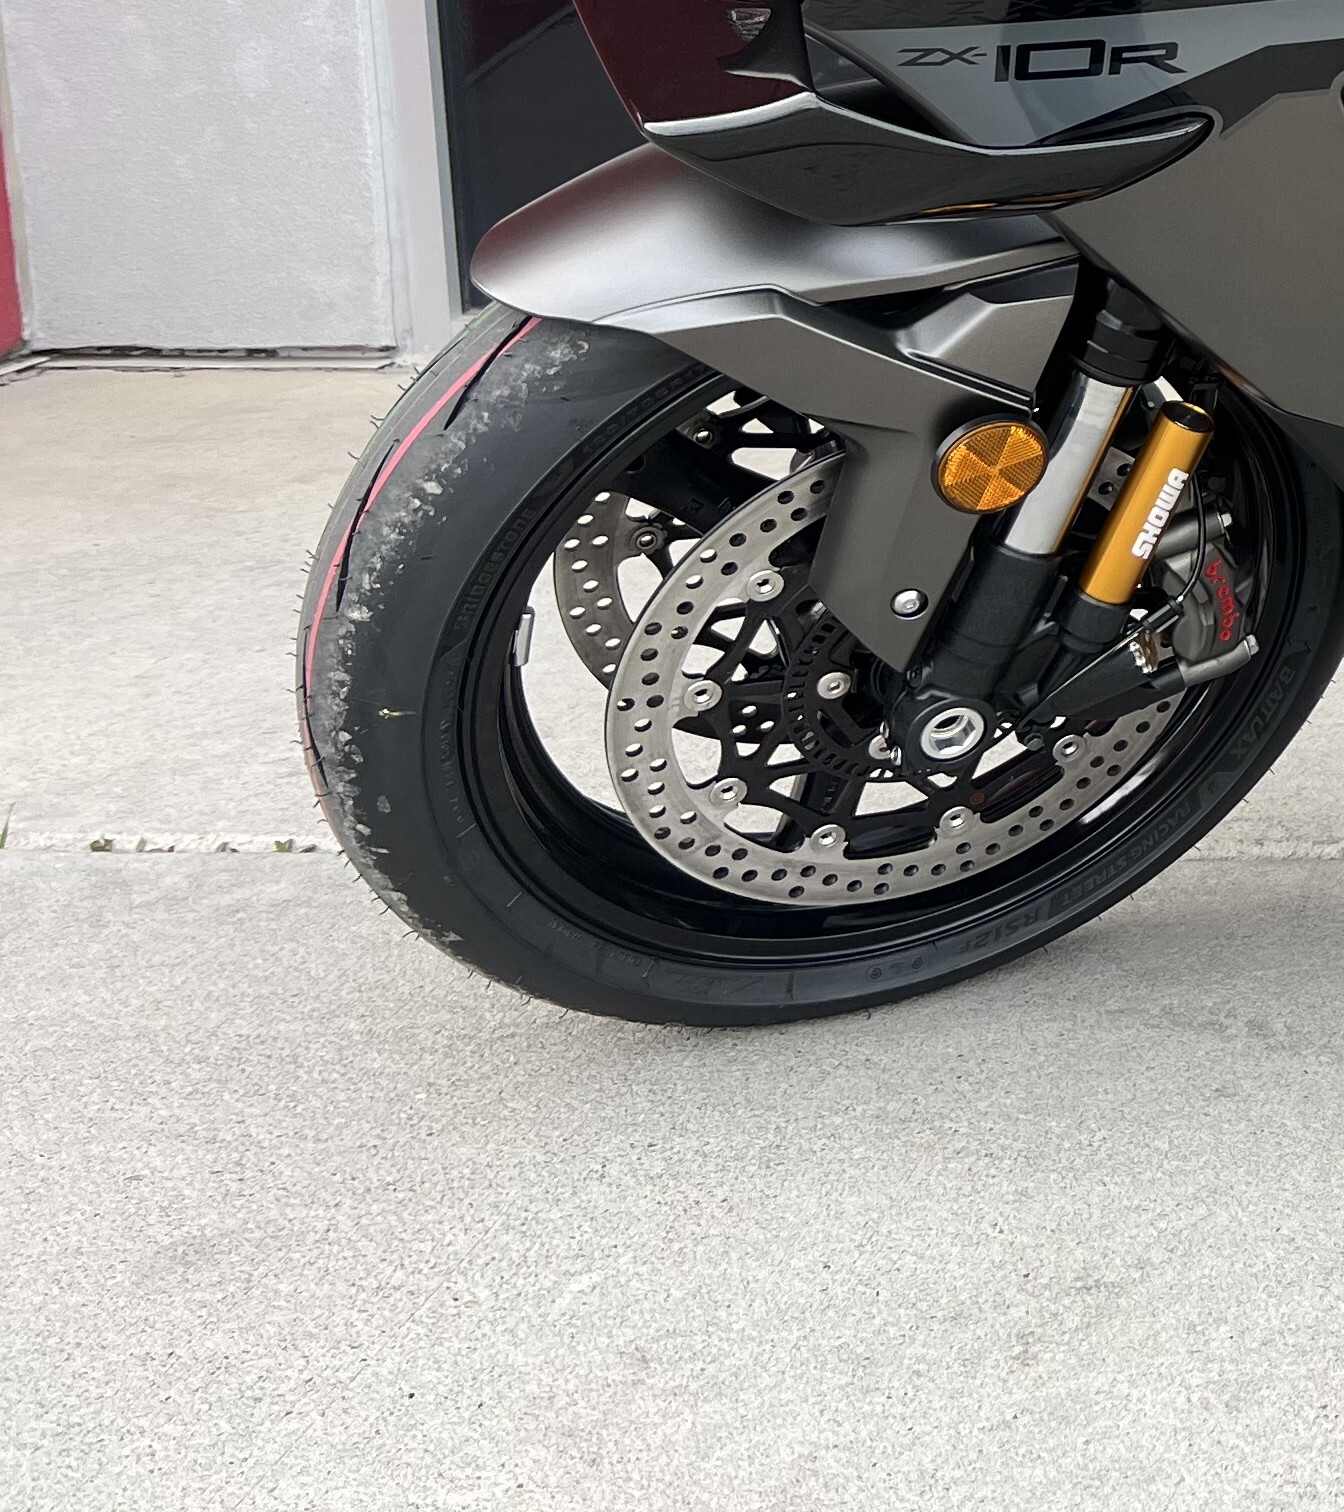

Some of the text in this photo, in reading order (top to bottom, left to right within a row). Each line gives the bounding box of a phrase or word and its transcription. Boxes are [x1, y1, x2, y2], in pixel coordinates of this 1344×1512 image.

[897, 39, 1188, 83] ZX-10R
[1132, 468, 1189, 560] SHOWA
[1206, 559, 1240, 641] brembo
[1228, 665, 1295, 760] BATTLAX
[1059, 801, 1191, 906] RACING STREET
